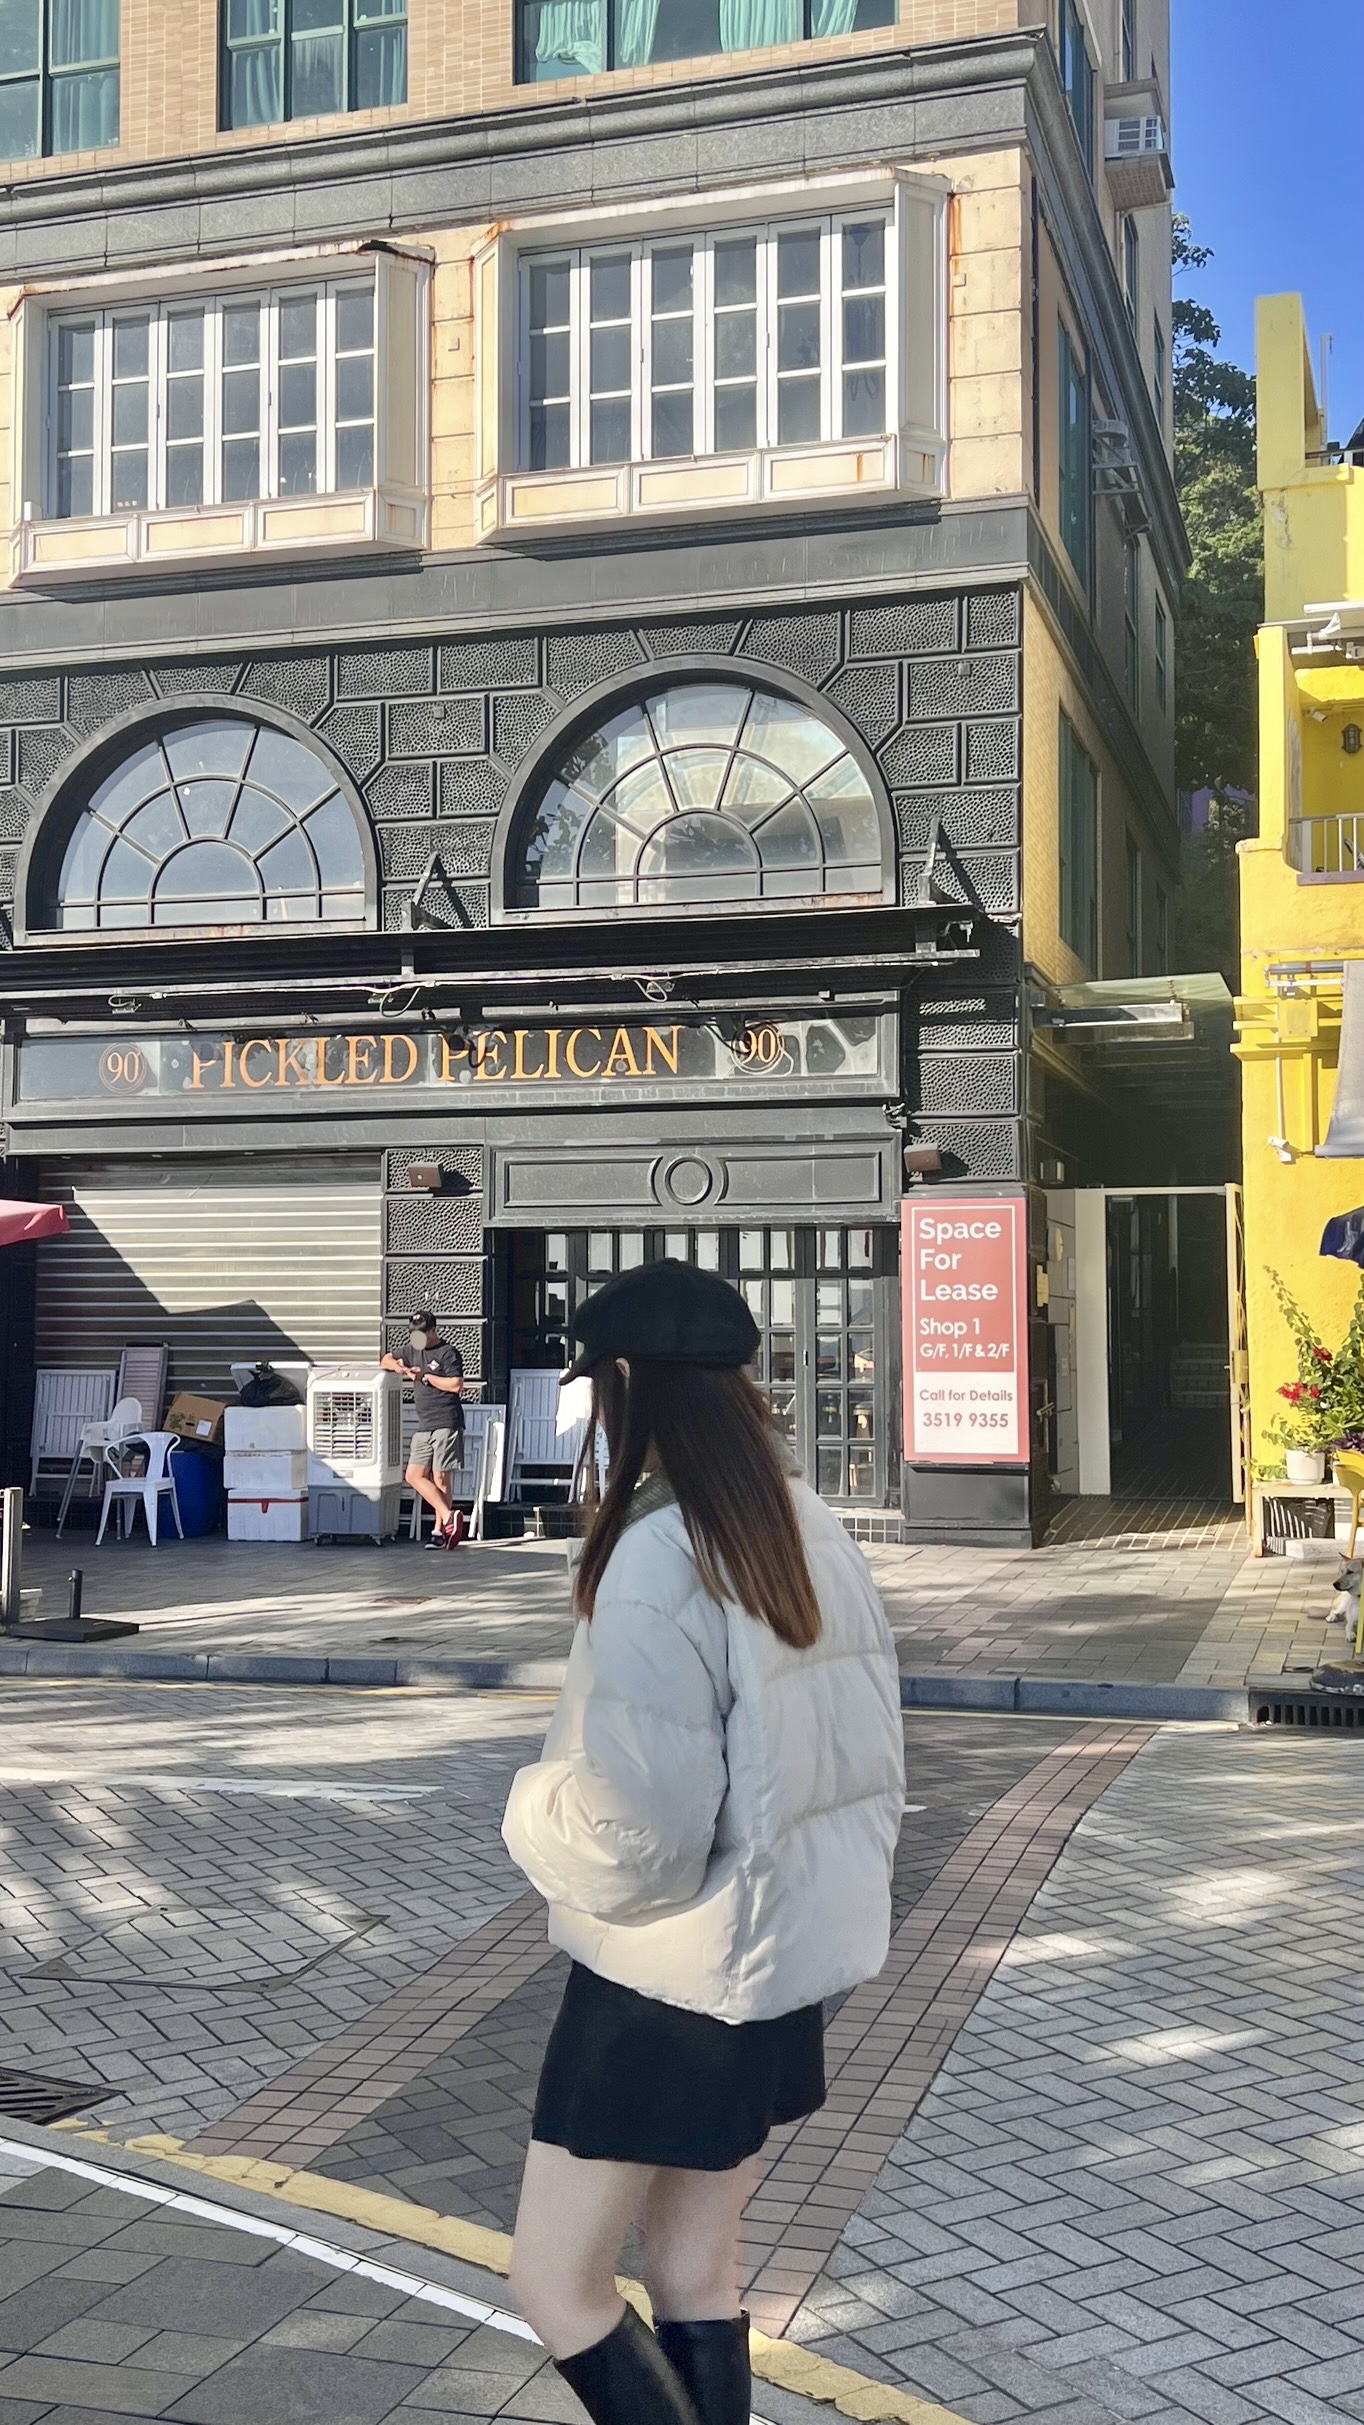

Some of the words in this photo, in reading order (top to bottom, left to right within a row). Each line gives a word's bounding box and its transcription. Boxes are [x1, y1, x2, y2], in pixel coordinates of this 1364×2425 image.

[739, 1028, 776, 1064] 90
[106, 1051, 139, 1083] 90
[189, 1034, 418, 1089] PICKLED
[439, 1025, 682, 1081] PELICAN
[919, 1218, 1002, 1244] Space
[920, 1249, 962, 1270] For
[920, 1280, 998, 1301] Lease
[919, 1318, 967, 1338] Shop
[973, 1318, 980, 1334] 1
[920, 1343, 949, 1359] G/F,
[952, 1343, 973, 1359] 1/F
[975, 1344, 985, 1357] &
[987, 1343, 1010, 1359] 2/F
[919, 1389, 945, 1401] Call
[948, 1389, 966, 1401] for
[970, 1389, 1013, 1401] Details
[922, 1412, 962, 1427] 3519
[968, 1412, 1009, 1427] 9355
